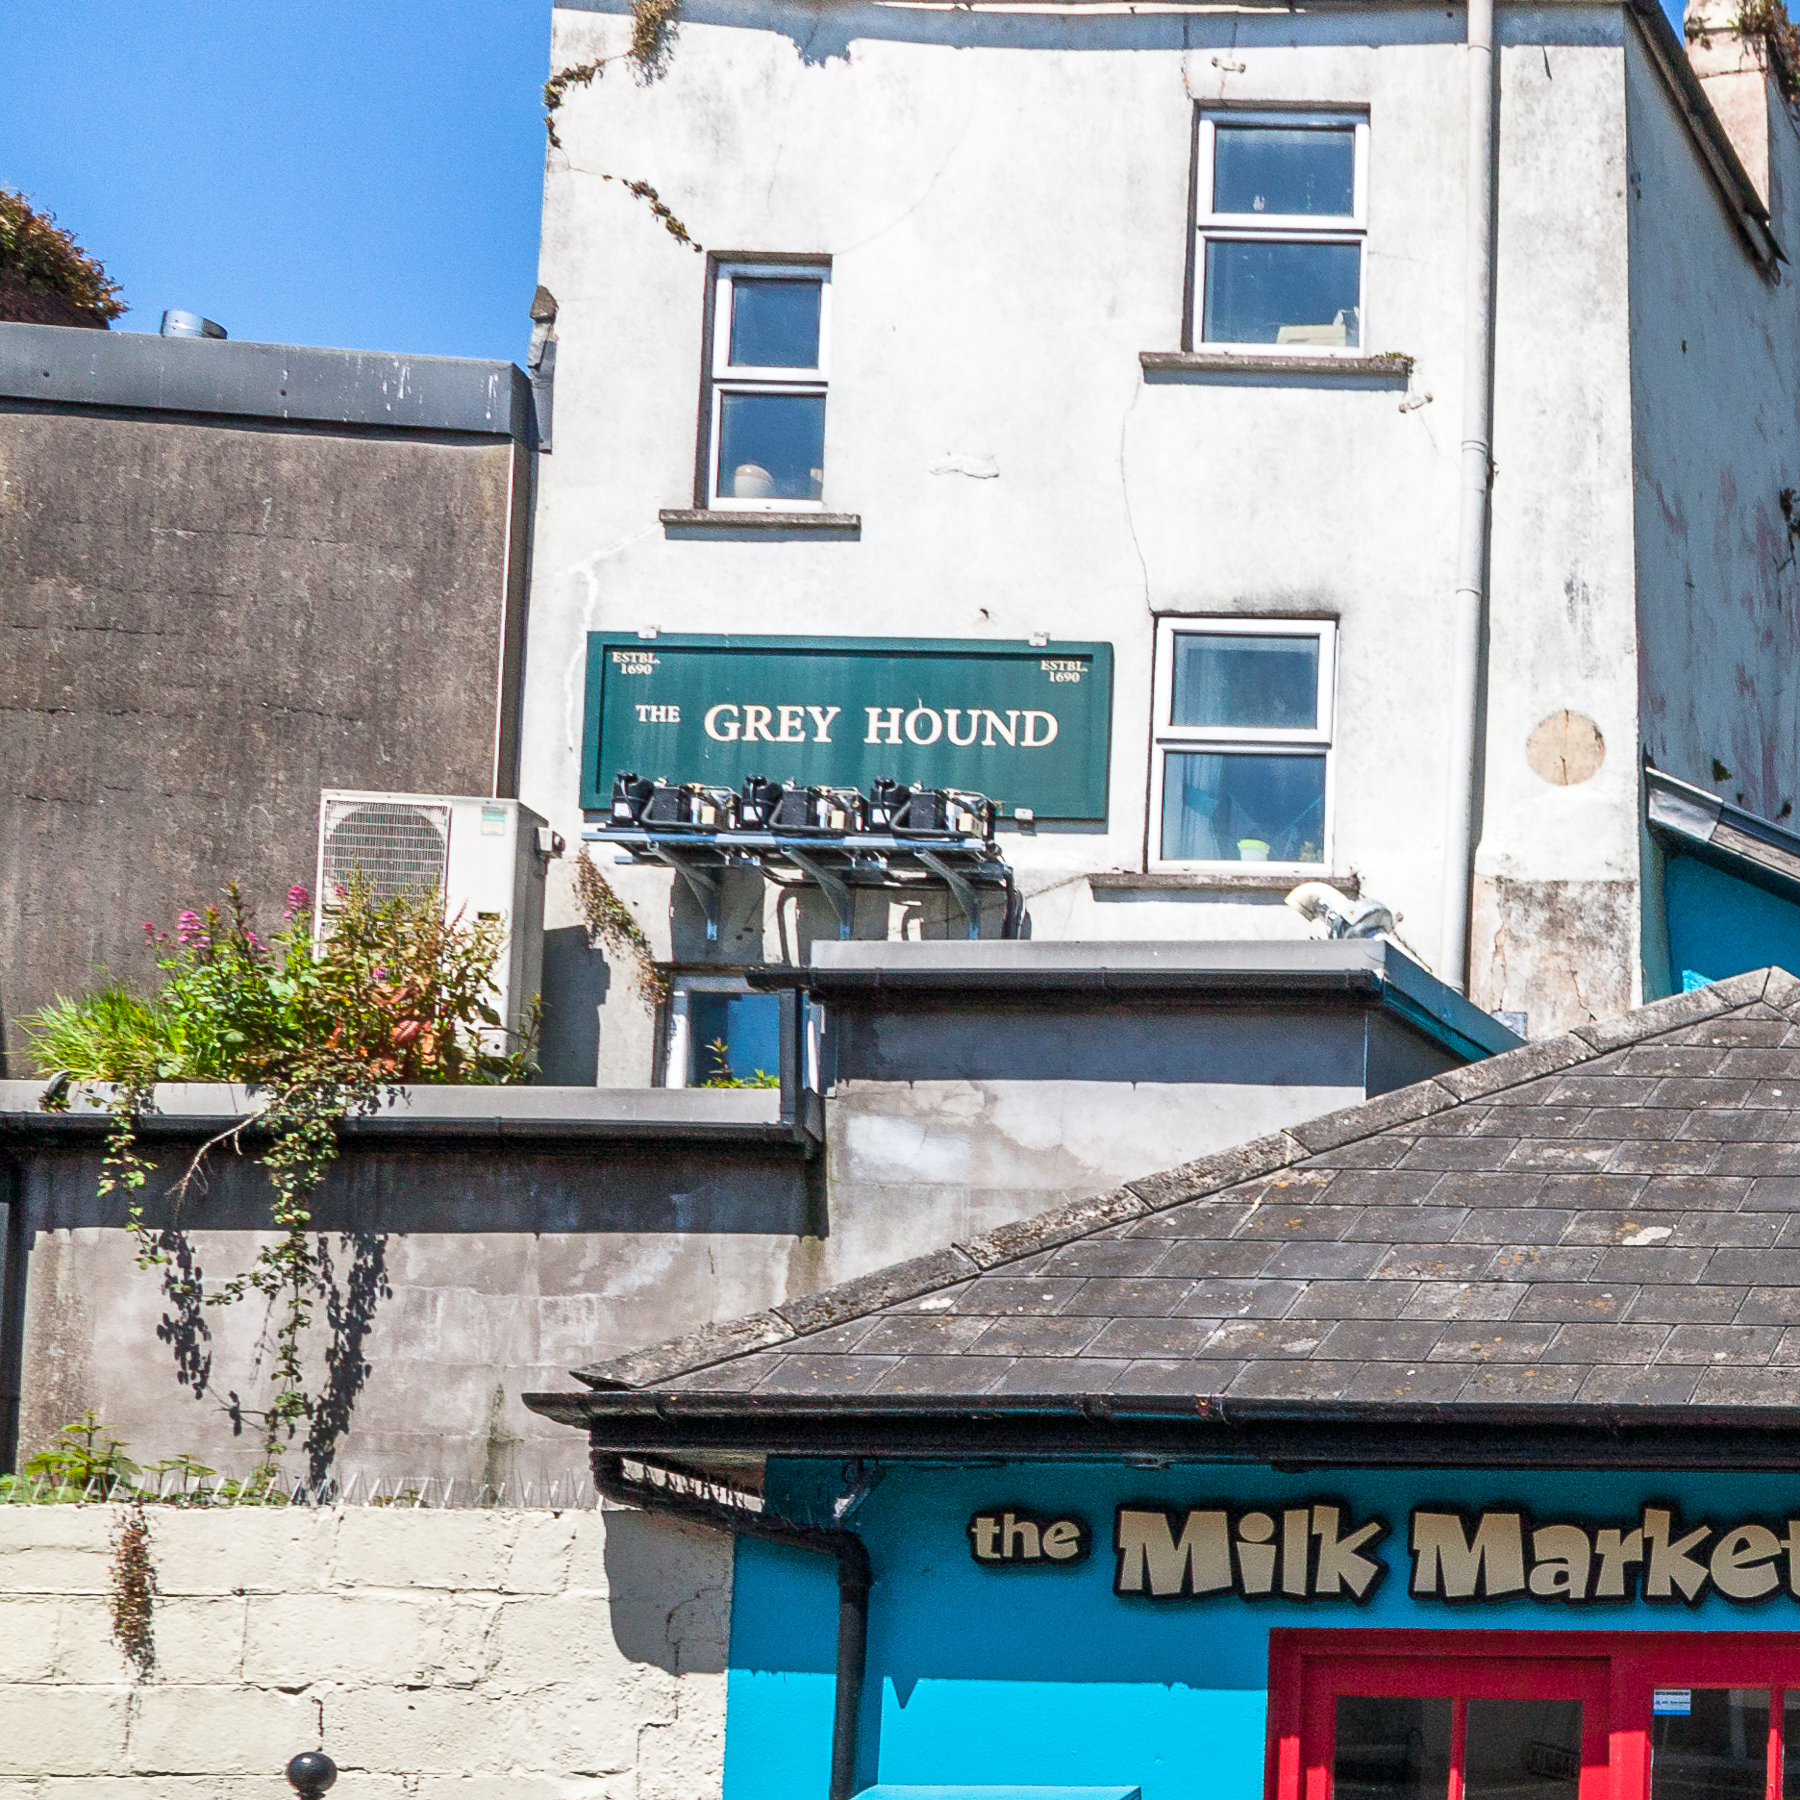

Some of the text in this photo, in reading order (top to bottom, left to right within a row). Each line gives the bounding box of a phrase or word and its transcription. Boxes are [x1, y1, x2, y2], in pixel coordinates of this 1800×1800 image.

[612, 652, 661, 664] ESTBL.
[621, 663, 653, 675] 1690
[1041, 659, 1088, 672] ESTBL.
[1049, 671, 1080, 683] 1690
[635, 704, 1058, 747] THE GREY HOUND
[972, 1512, 1081, 1560] the
[1118, 1503, 1384, 1600] Milk
